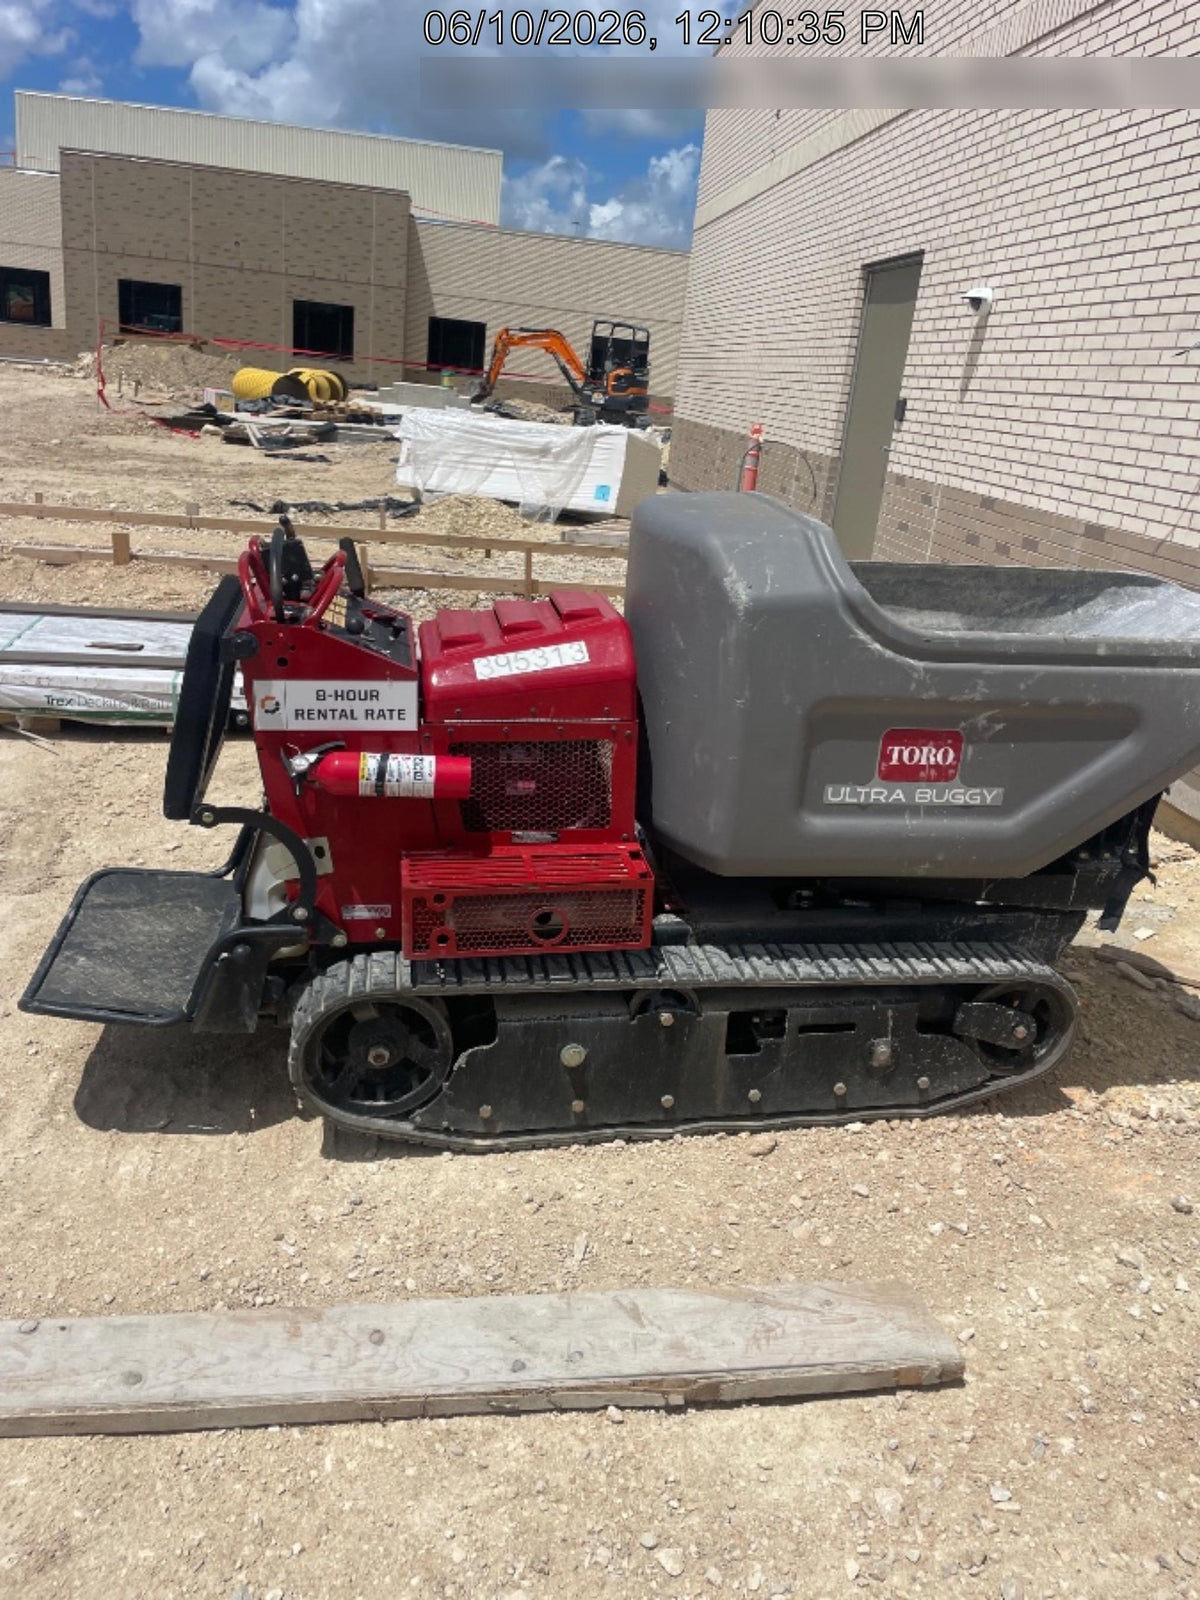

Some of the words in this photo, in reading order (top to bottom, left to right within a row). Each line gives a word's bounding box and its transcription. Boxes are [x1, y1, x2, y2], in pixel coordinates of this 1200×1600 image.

[477, 643, 586, 677] 395313
[44, 694, 74, 707] Trex
[315, 688, 380, 702] 8-HOUR
[294, 708, 358, 721] RENTAL
[365, 708, 406, 721] RATE
[887, 745, 956, 766] TORO
[827, 787, 906, 802] ULTRA
[915, 788, 998, 804] BUGGY
